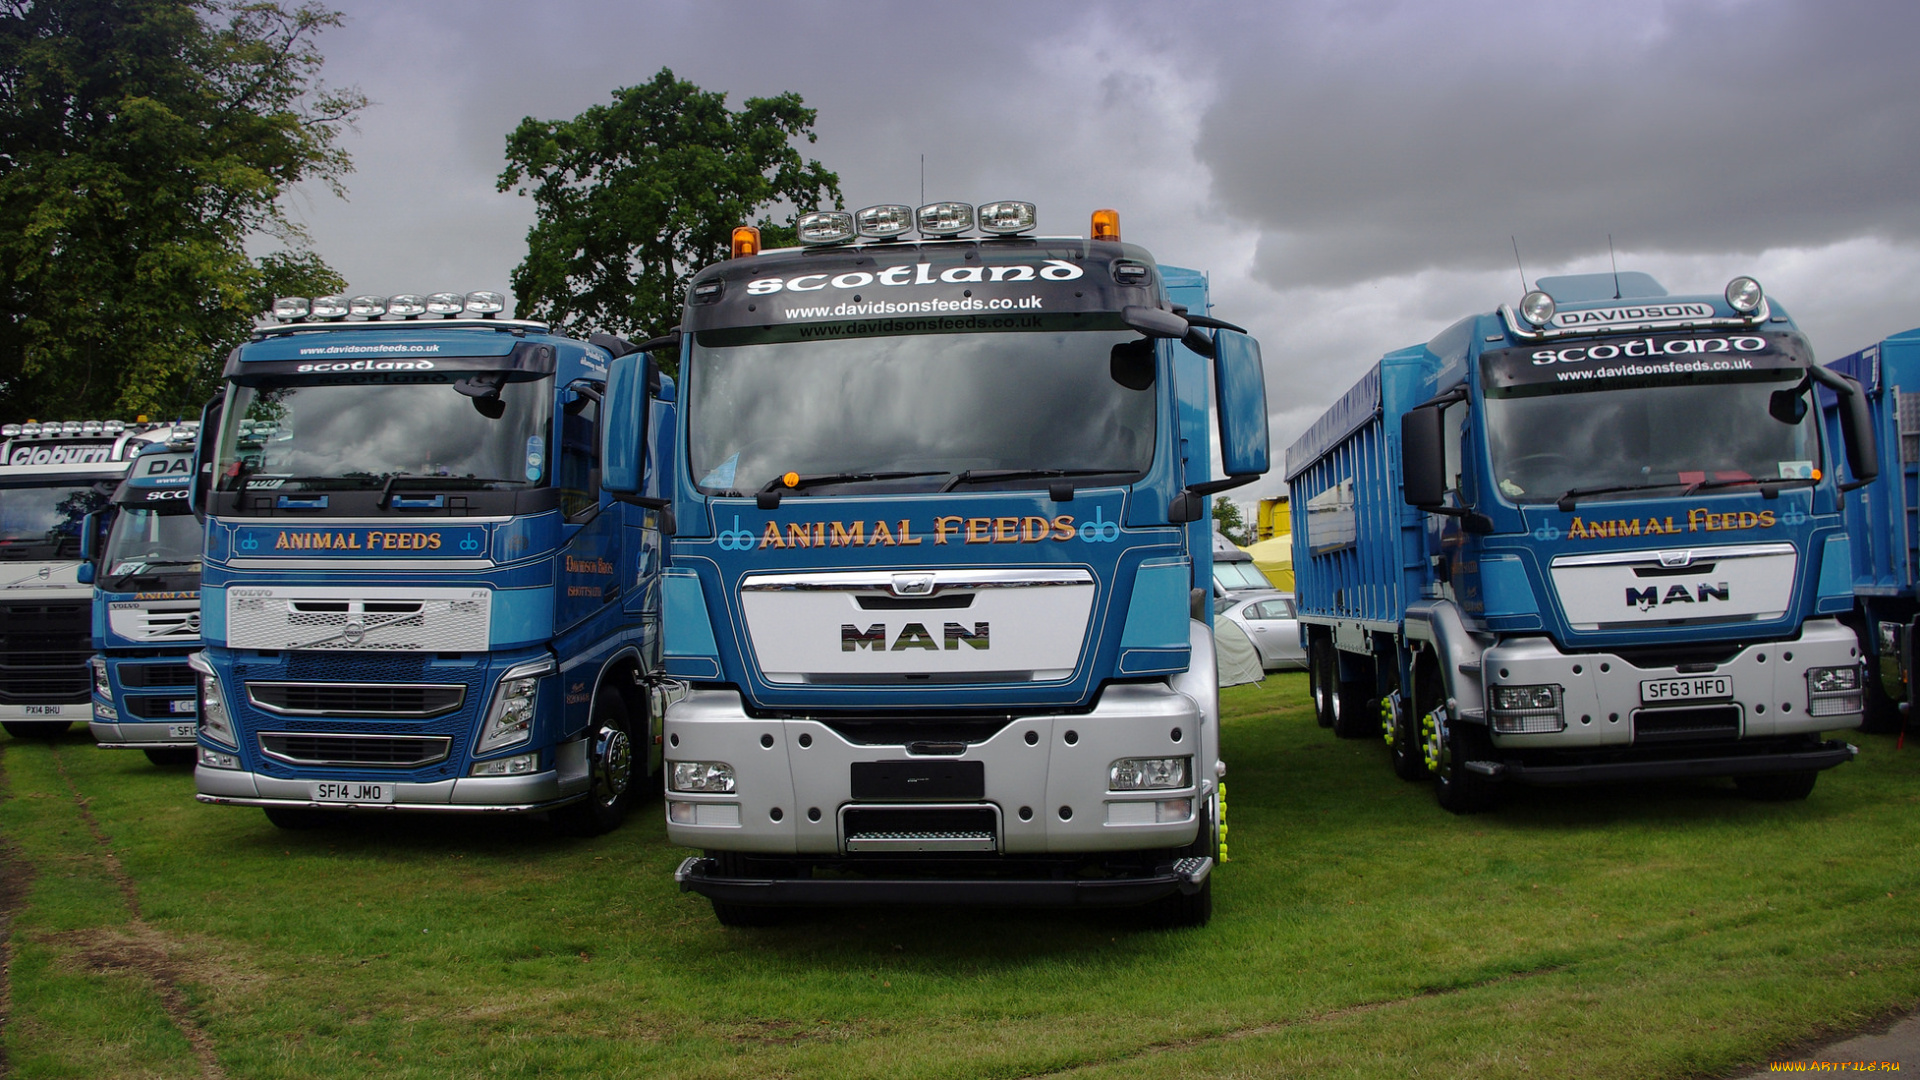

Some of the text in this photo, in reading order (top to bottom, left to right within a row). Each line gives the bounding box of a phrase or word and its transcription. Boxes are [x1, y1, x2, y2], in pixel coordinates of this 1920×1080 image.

[746, 259, 1084, 295] scotland
[785, 295, 1043, 319] www.davidsonsfeeds.co.uk
[1560, 304, 1705, 325] DAVIDSON
[299, 343, 440, 355] www.davidsonsfeeds.co.uk
[1531, 335, 1767, 366] scotland
[297, 360, 435, 373] scotland
[1556, 358, 1752, 382] www.davidsonsfeeds.co.uk
[10, 445, 111, 466] Cloburn
[148, 457, 194, 475] DA
[758, 519, 922, 550] ANIMAL
[932, 514, 1076, 546] FEEDS
[1567, 515, 1682, 541] ANIMAL
[1687, 508, 1777, 533] FEEDS
[275, 531, 361, 550] ANIMAL
[366, 531, 442, 550] FEEDS
[229, 589, 488, 598] VOLVO FH
[1626, 582, 1729, 607] MAN
[841, 621, 991, 653] MAN
[1649, 679, 1726, 698] SF63 HFO
[318, 784, 382, 800] SF14 JMO
